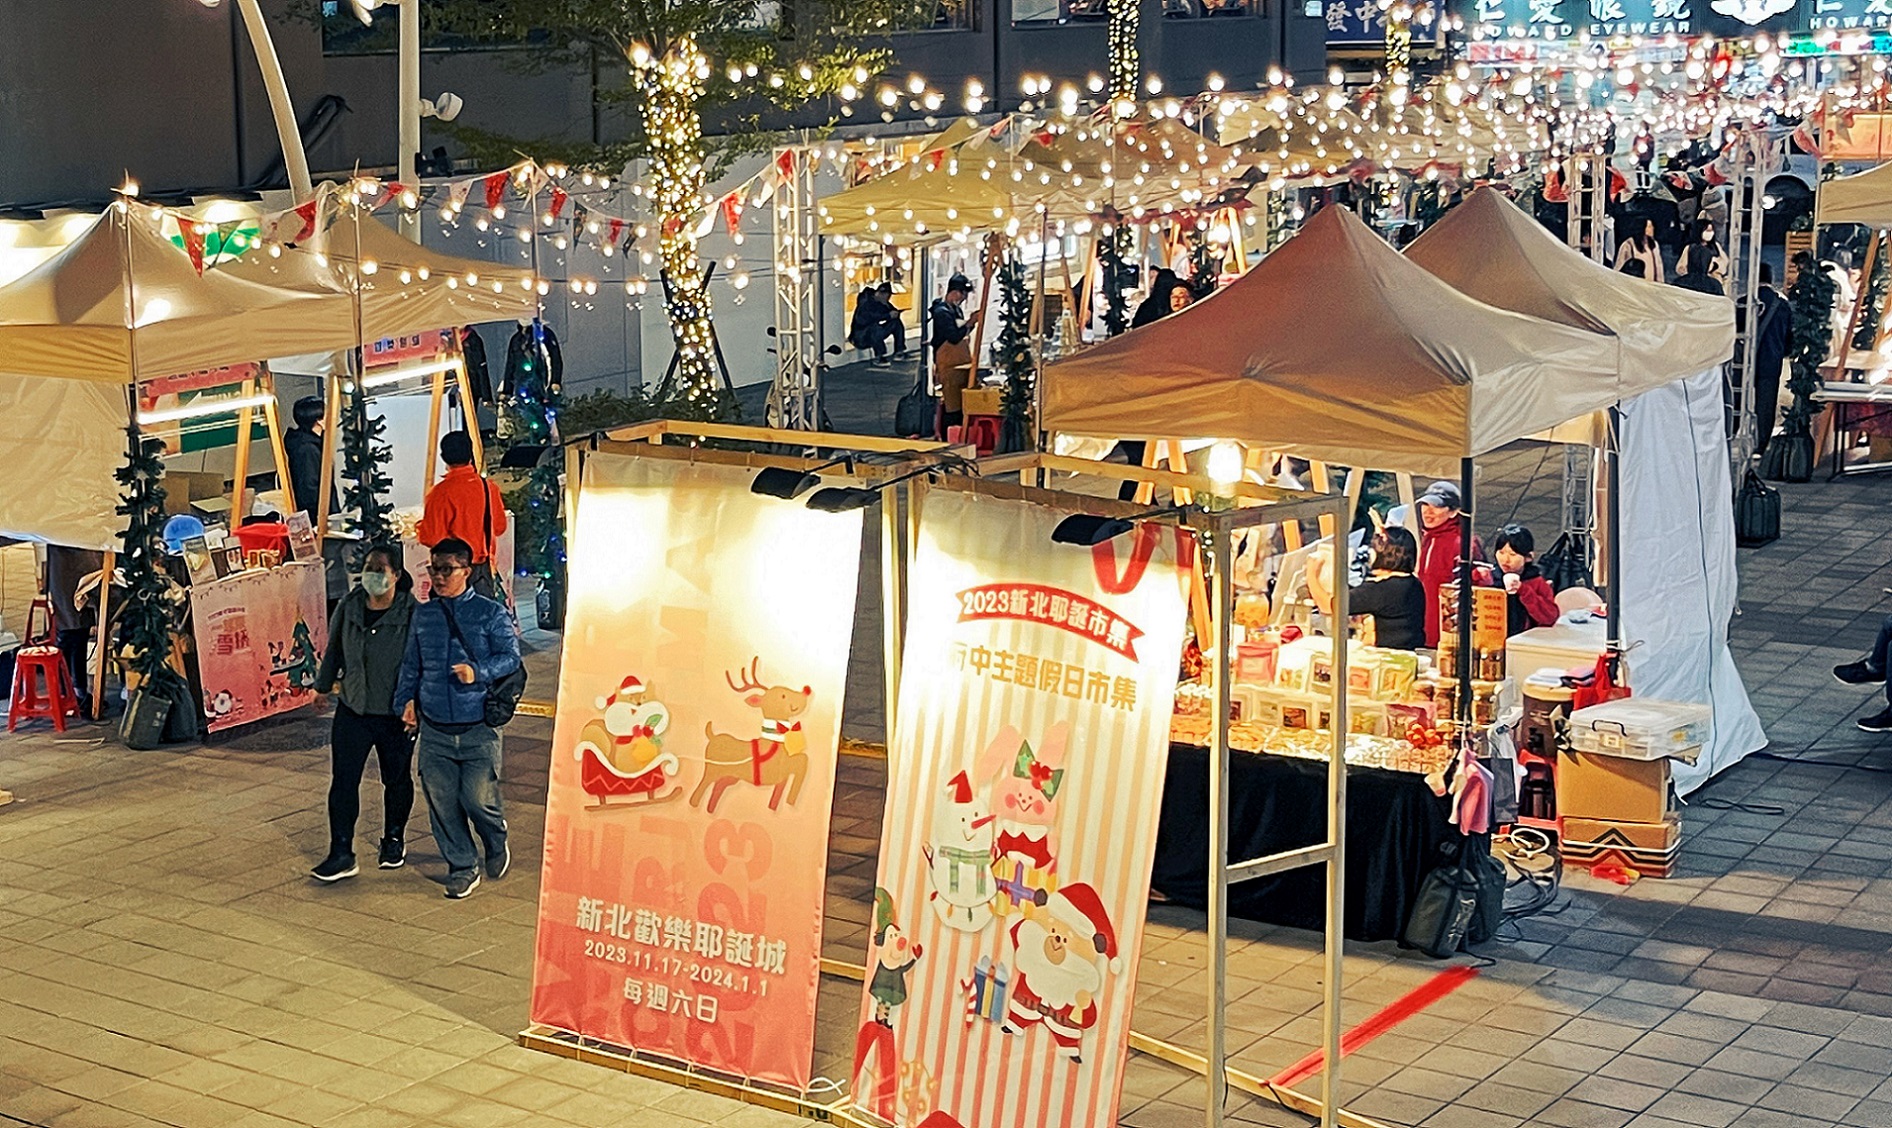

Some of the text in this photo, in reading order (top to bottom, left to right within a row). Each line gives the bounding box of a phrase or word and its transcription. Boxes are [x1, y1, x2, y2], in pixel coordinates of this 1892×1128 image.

[1590, 21, 1690, 36] EYEWEAR
[1810, 15, 1892, 29] HOWAR
[963, 588, 1131, 651] 2023新北耶誕市集
[575, 896, 787, 975] 新北歡樂耶誕城
[584, 939, 768, 997] 2023.11.17-2024.1.1
[623, 976, 718, 1023] 每週六日
